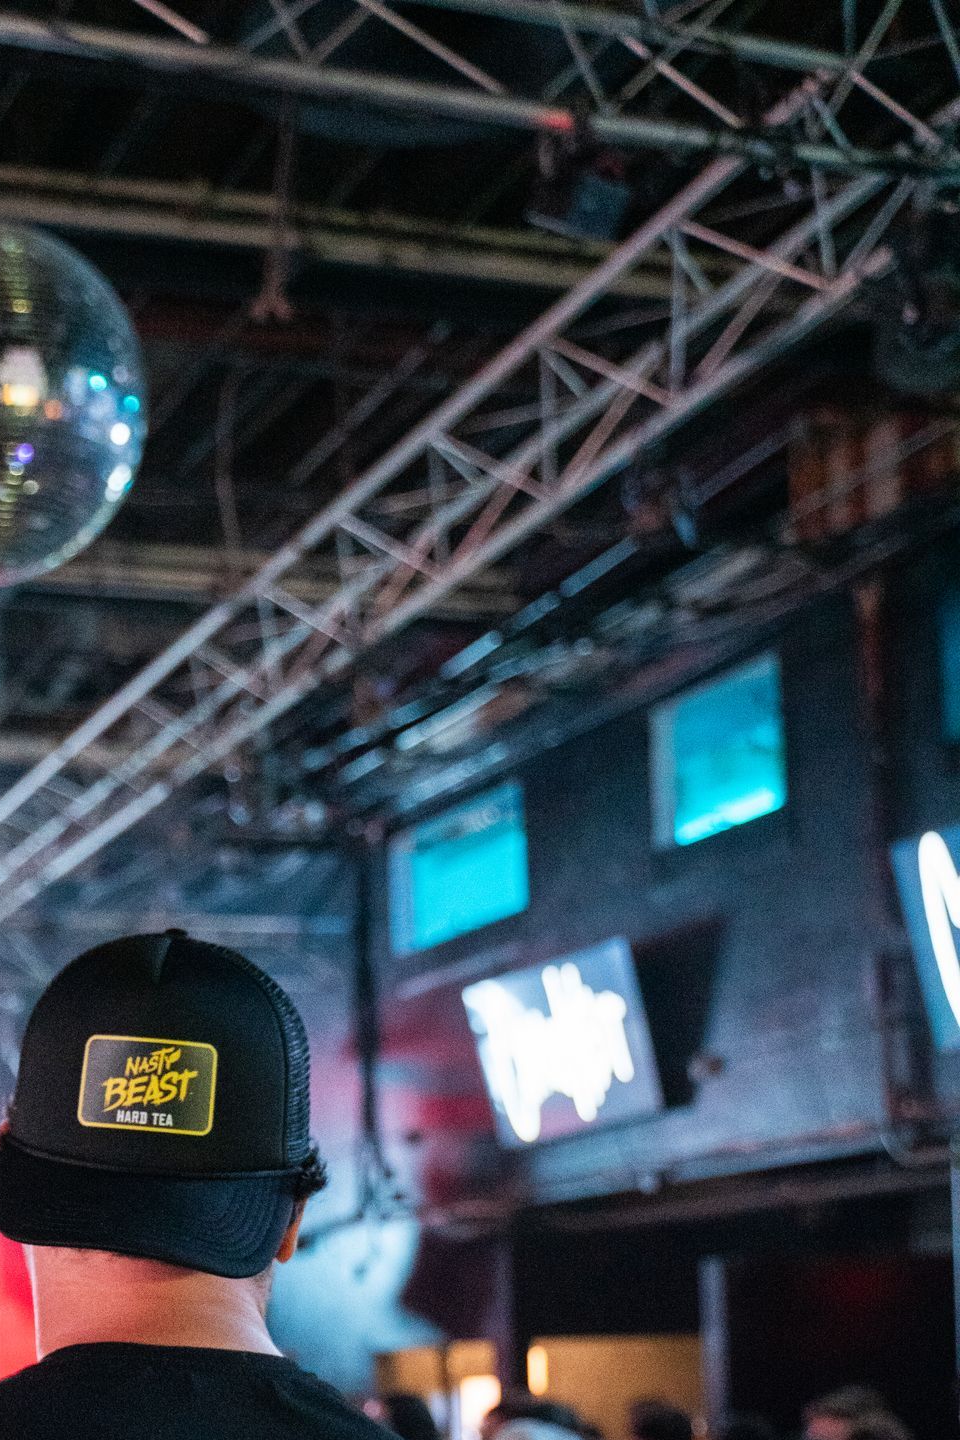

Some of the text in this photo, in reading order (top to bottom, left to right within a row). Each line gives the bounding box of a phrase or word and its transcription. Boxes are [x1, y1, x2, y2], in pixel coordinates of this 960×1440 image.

[125, 1047, 181, 1076] NASTY
[102, 1069, 198, 1112] BEAST
[116, 1110, 173, 1126] HARD TEA
